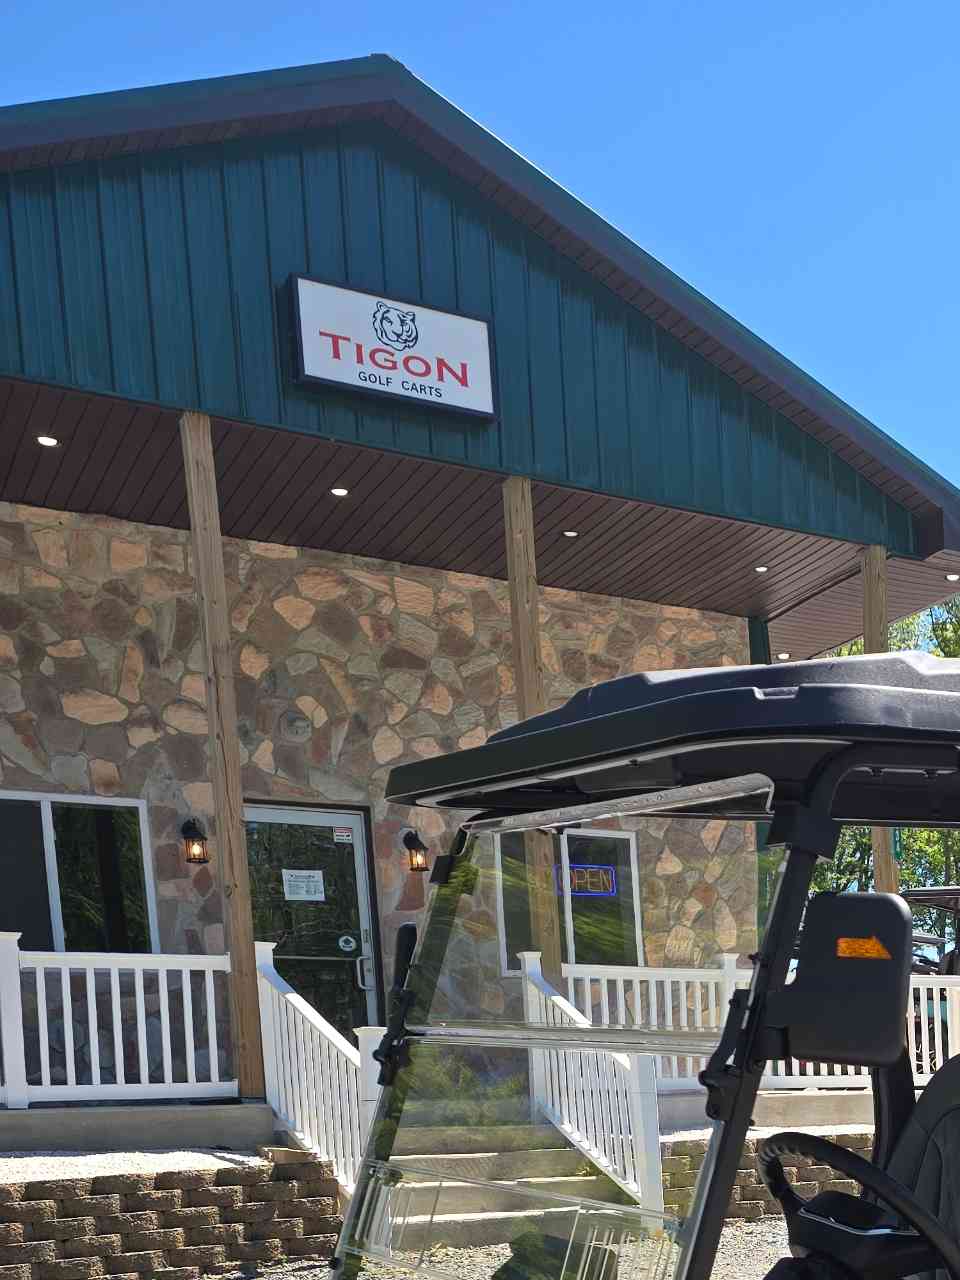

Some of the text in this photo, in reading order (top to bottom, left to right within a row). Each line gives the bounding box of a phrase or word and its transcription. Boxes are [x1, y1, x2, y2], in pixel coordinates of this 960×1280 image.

[319, 328, 470, 388] TIGON
[358, 370, 443, 398] GOLF CARTS
